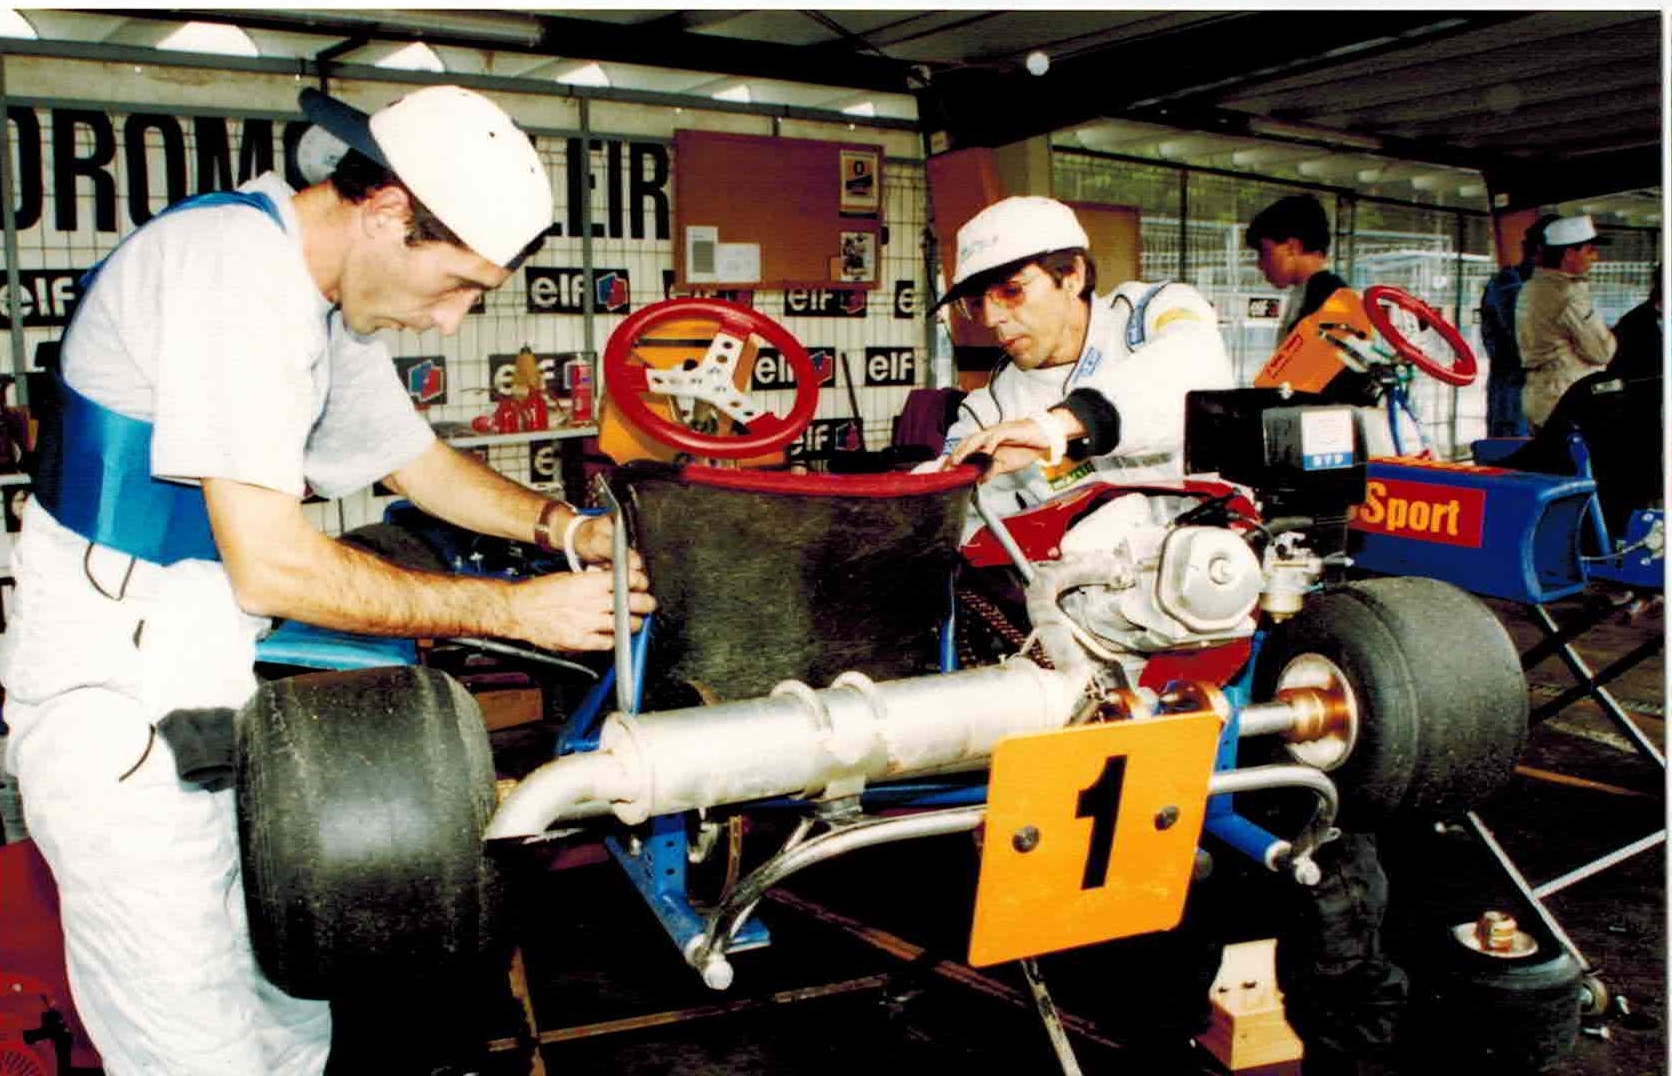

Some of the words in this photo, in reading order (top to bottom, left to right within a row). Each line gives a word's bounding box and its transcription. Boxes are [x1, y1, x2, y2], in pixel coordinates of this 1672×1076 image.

[553, 138, 671, 240] EIR
[0, 276, 76, 318] elf
[531, 273, 584, 308] elf
[788, 287, 832, 312] elf
[494, 359, 555, 397] ef
[868, 352, 914, 382] elf
[1360, 481, 1460, 536] Sport
[1075, 754, 1128, 891] 1
